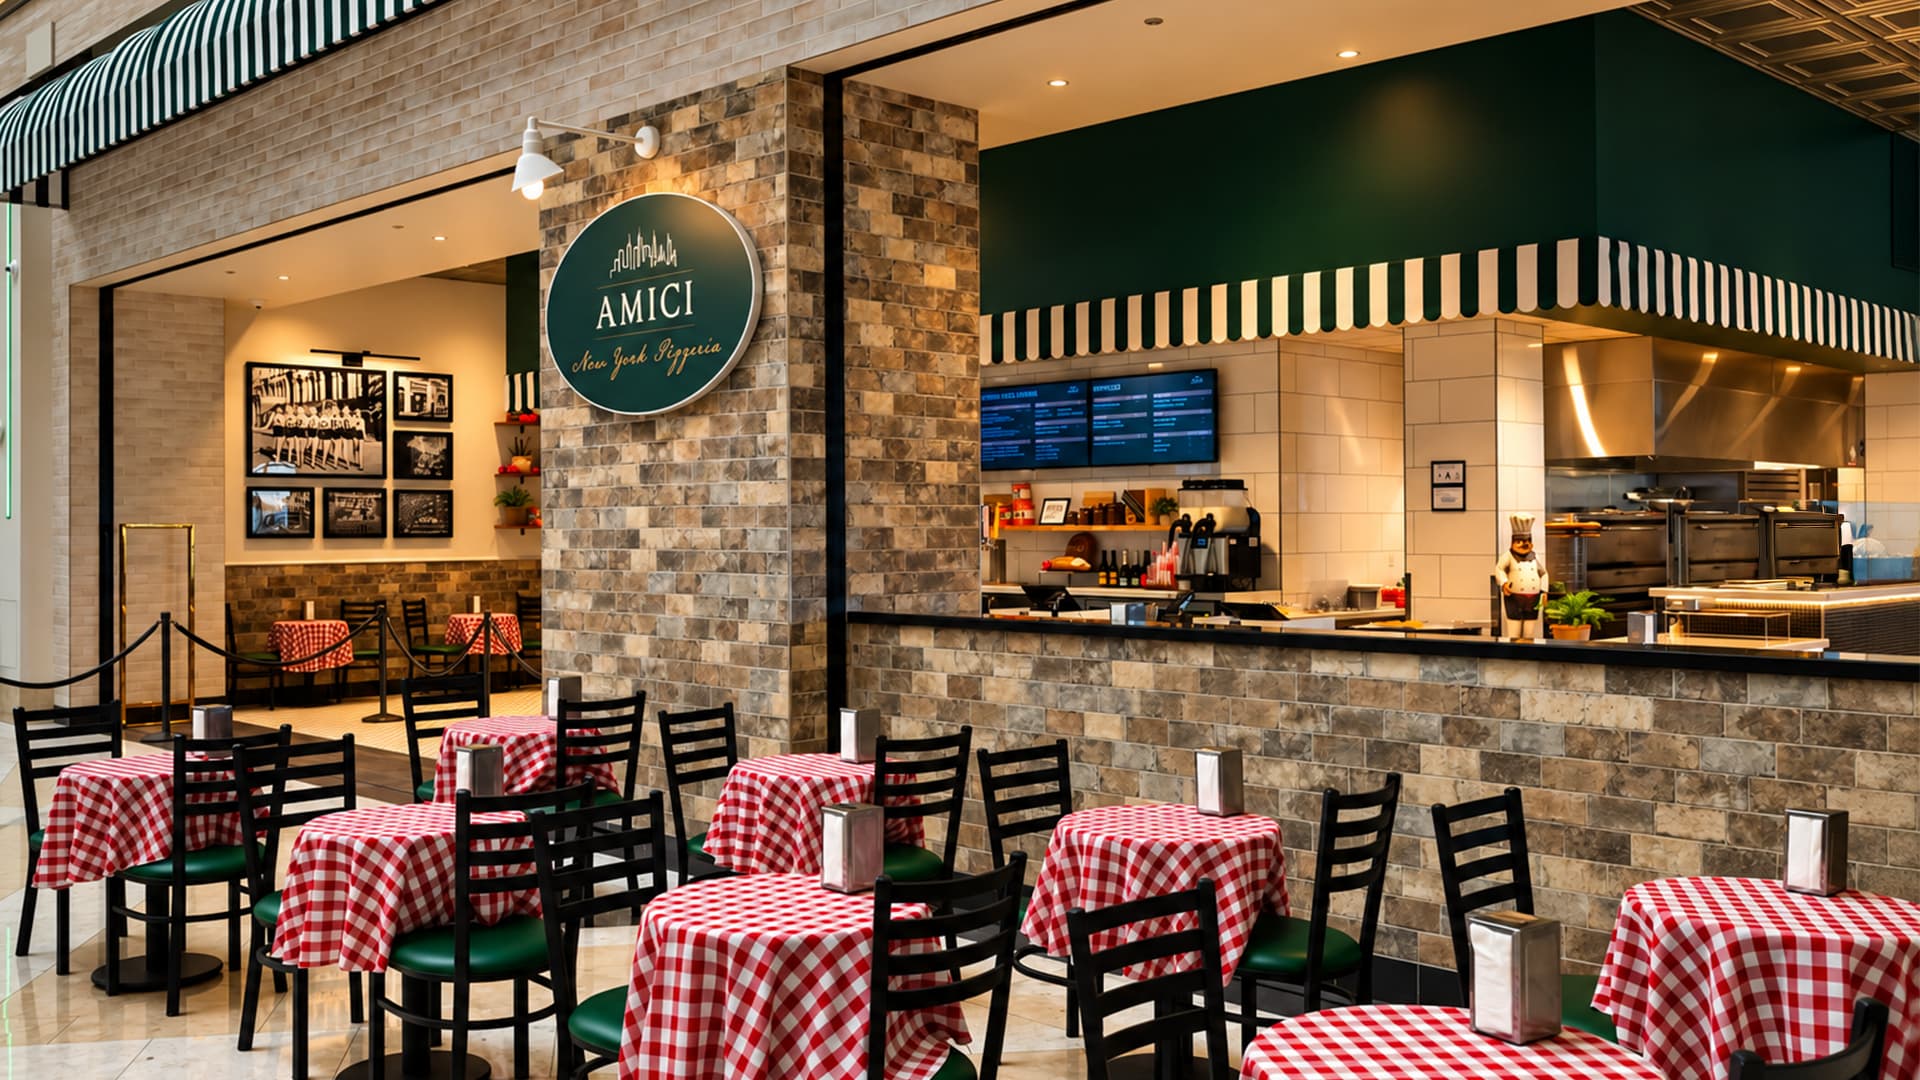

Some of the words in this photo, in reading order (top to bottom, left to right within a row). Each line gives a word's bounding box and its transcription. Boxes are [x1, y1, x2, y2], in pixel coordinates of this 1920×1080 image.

[596, 280, 693, 330] AMICI
[572, 350, 608, 373] New
[610, 344, 648, 381] York
[654, 337, 722, 376] Pizzeria
